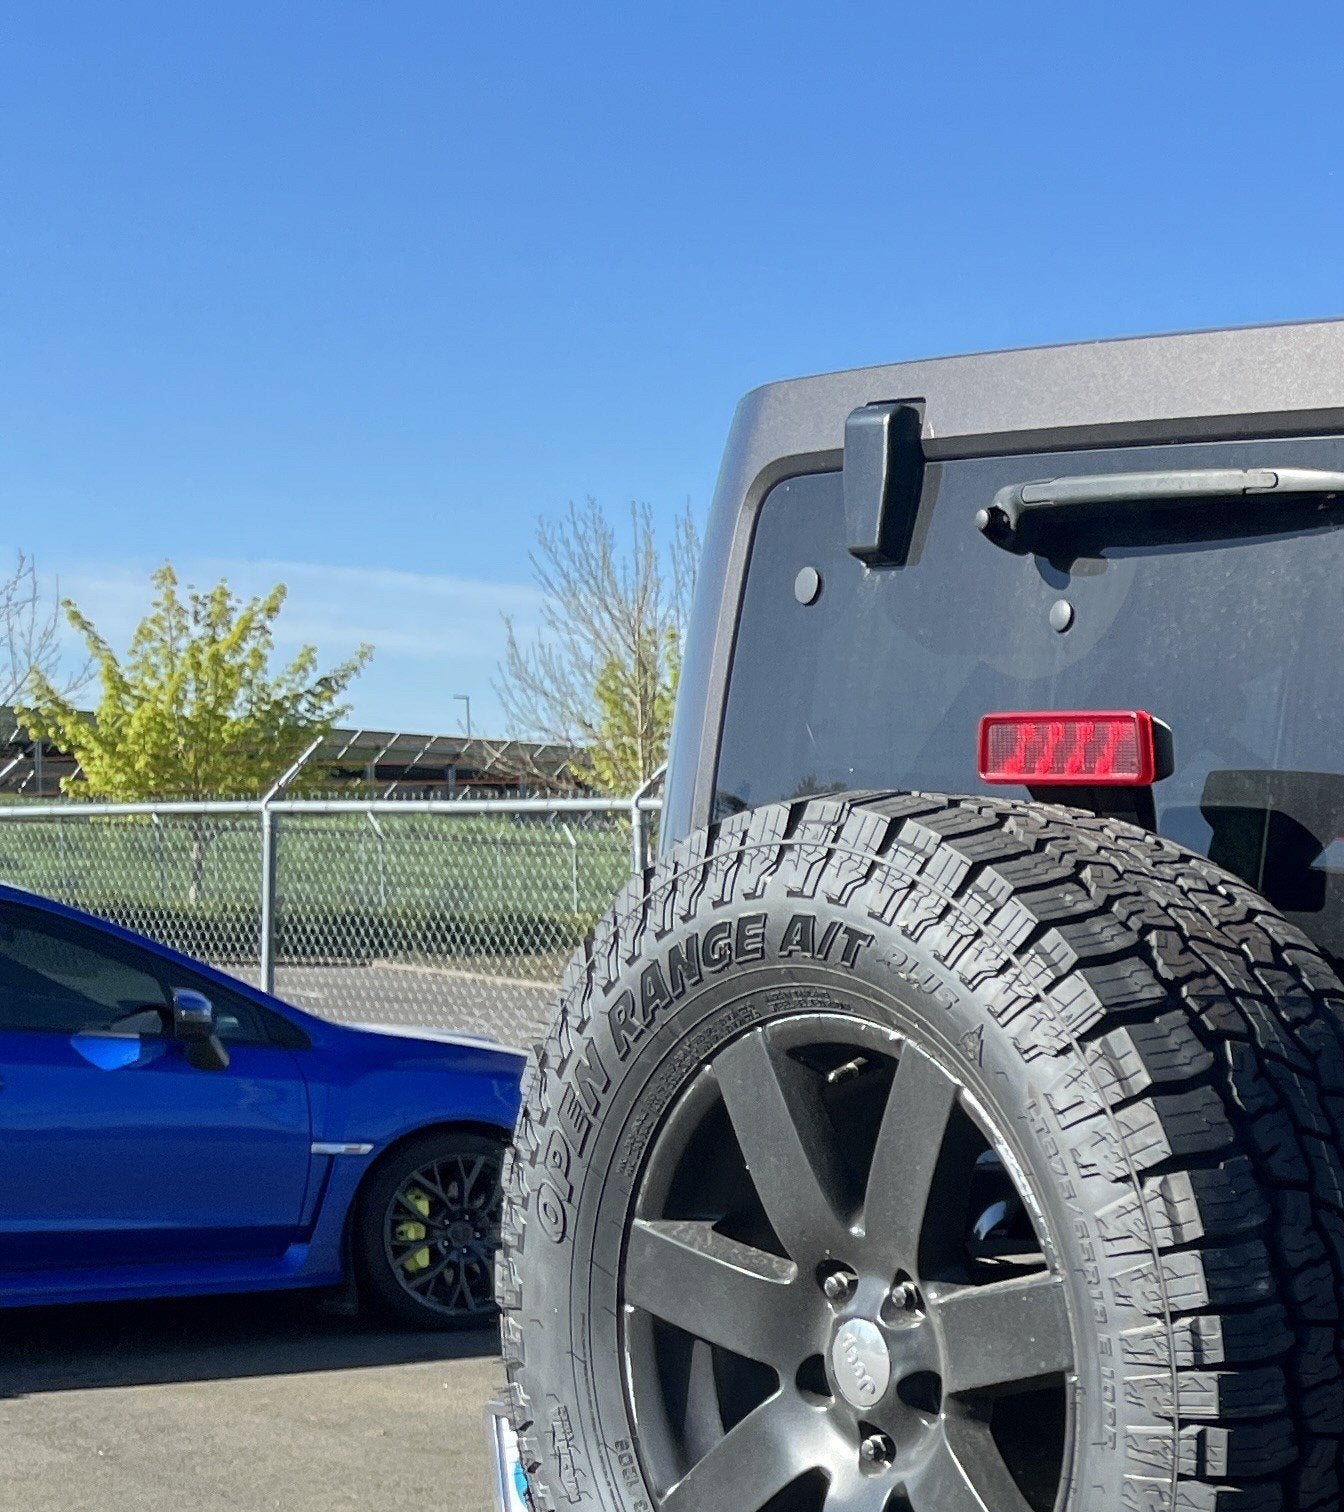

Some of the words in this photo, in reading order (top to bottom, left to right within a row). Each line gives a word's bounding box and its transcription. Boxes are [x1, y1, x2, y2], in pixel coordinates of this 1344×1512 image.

[536, 1037, 611, 1244] OPEN
[606, 912, 768, 1061] RANGE
[779, 914, 876, 969] A/T
[876, 945, 961, 1010] PLUS
